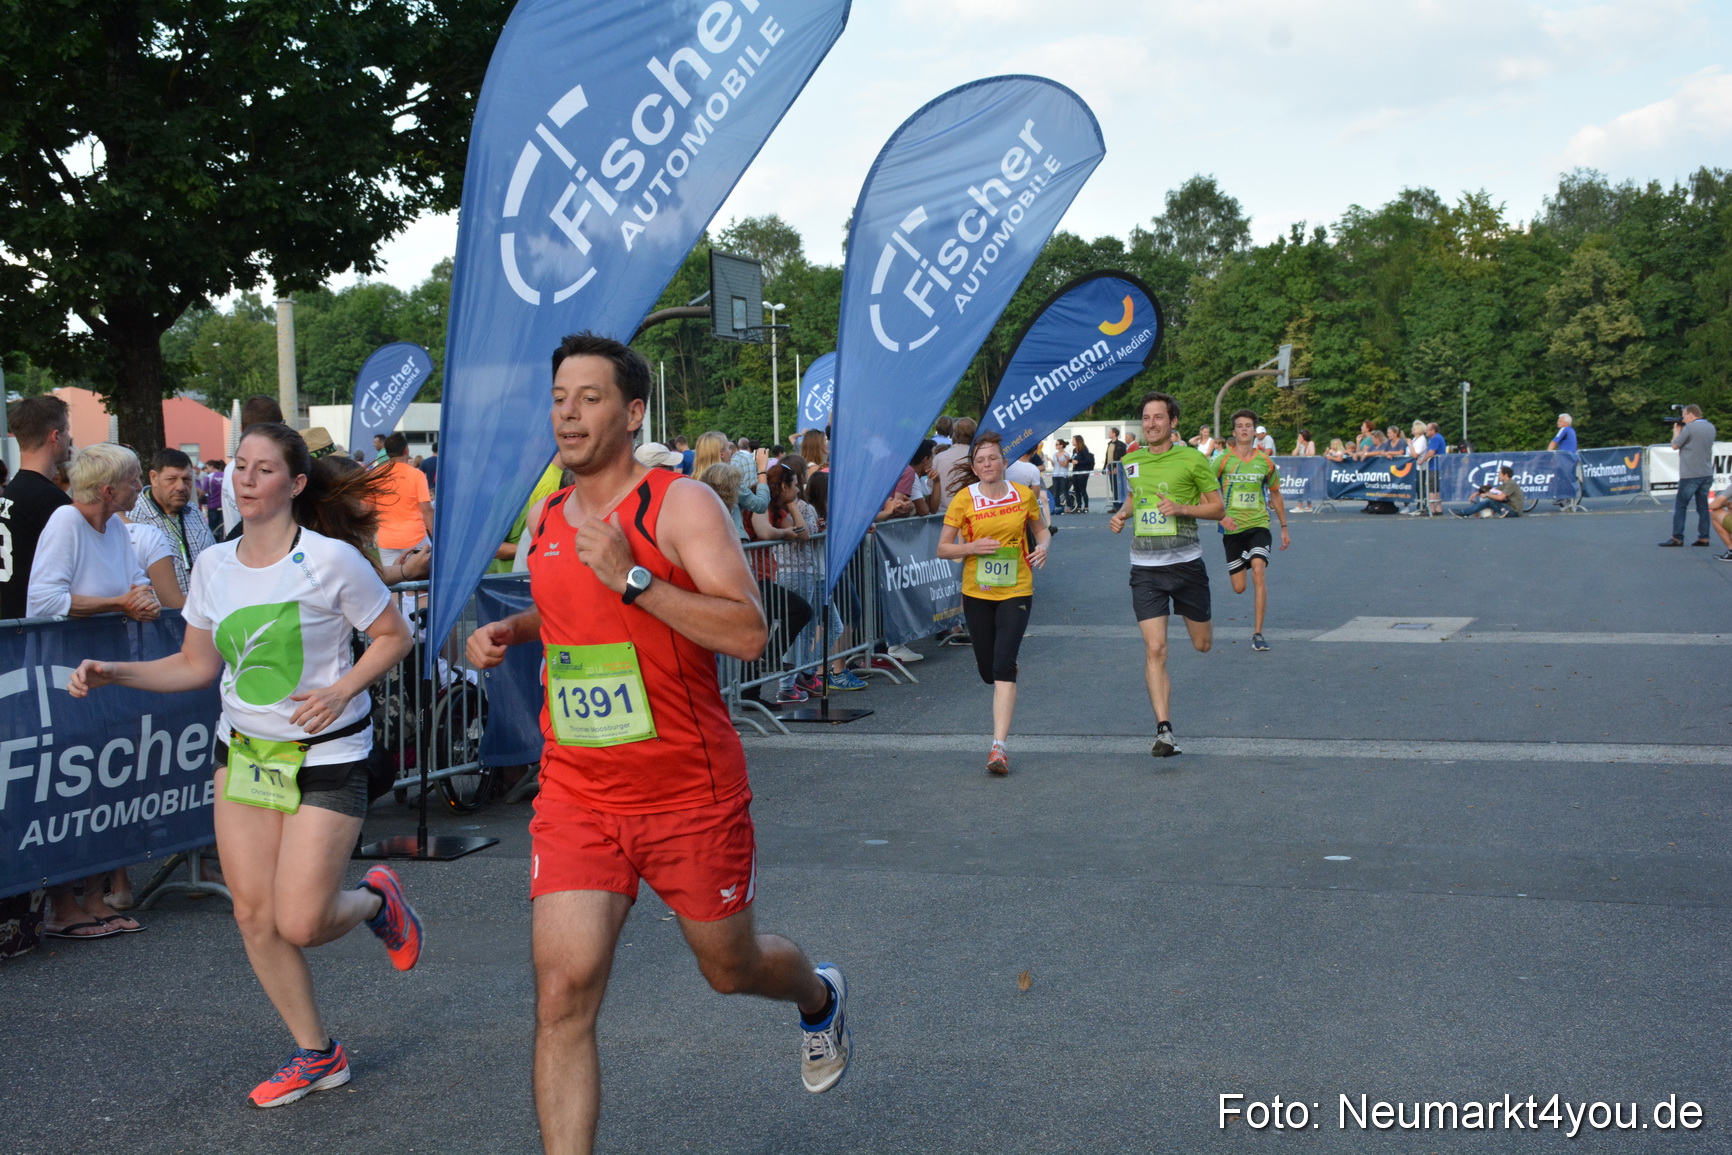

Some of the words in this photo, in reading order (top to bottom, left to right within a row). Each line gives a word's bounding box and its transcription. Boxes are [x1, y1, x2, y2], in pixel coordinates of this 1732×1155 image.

[620, 15, 786, 252] AUTOMOBILE
[903, 118, 1045, 318] Fischer
[954, 153, 1062, 315] AUTOMOBILE
[1068, 366, 1098, 393] Druck
[1115, 328, 1152, 363] Medien
[371, 355, 416, 417] Fischer
[387, 367, 421, 417] AUTOMOBILE
[992, 338, 1111, 430] Frischmann
[1279, 474, 1309, 487] cher
[1330, 469, 1391, 483] Frischmann
[1483, 471, 1555, 486] Ficher
[1582, 463, 1627, 478] Frischmann
[975, 510, 997, 521] MAX
[999, 505, 1025, 516] BÖGL
[1239, 493, 1256, 503] 125
[1141, 511, 1167, 525] 483
[884, 554, 952, 592] Frischmann
[984, 561, 1010, 576] 901
[929, 583, 945, 601] Druck
[944, 580, 956, 597] und
[558, 683, 633, 719] 1391
[18, 780, 215, 851] AUTOMOBILE
